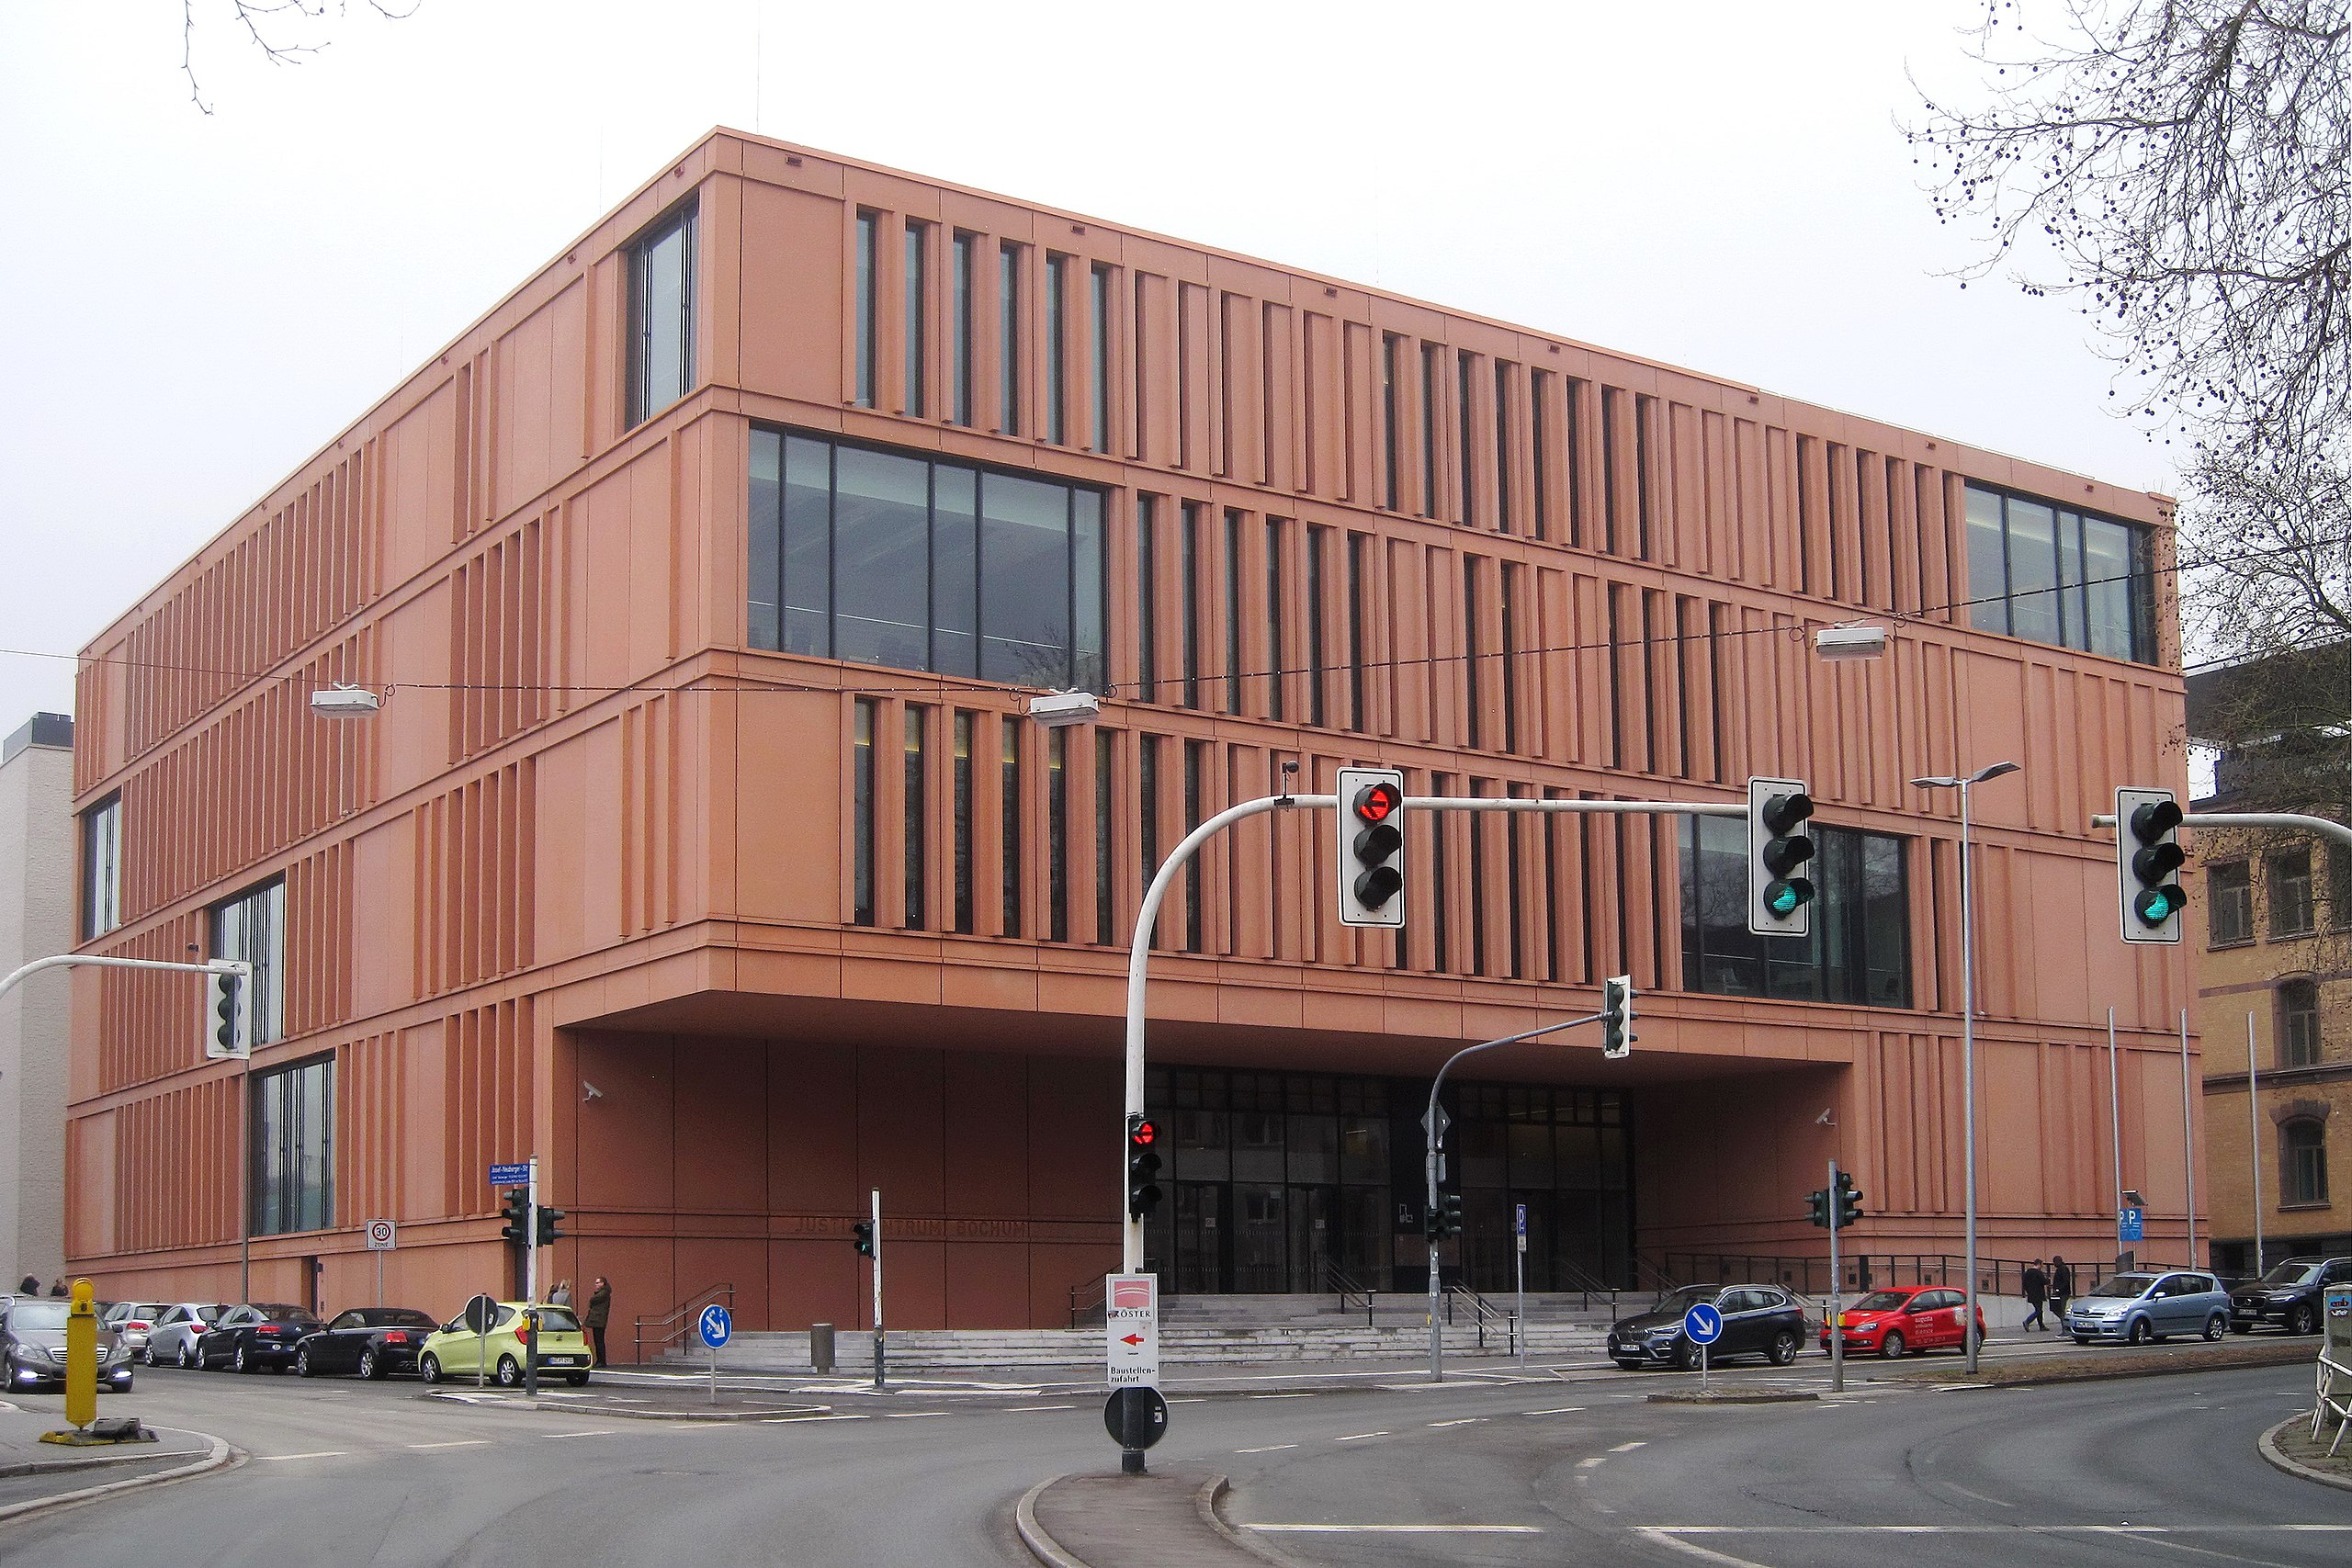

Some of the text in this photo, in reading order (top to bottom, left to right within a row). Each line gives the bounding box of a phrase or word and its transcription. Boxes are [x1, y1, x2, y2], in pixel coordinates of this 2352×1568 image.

[2129, 1210, 2136, 1224] P
[376, 1227, 387, 1236] 30
[956, 1220, 1027, 1235] BOCHUM
[1111, 1366, 1155, 1374] Baustellen-
[1111, 1375, 1139, 1383] zufahrt
